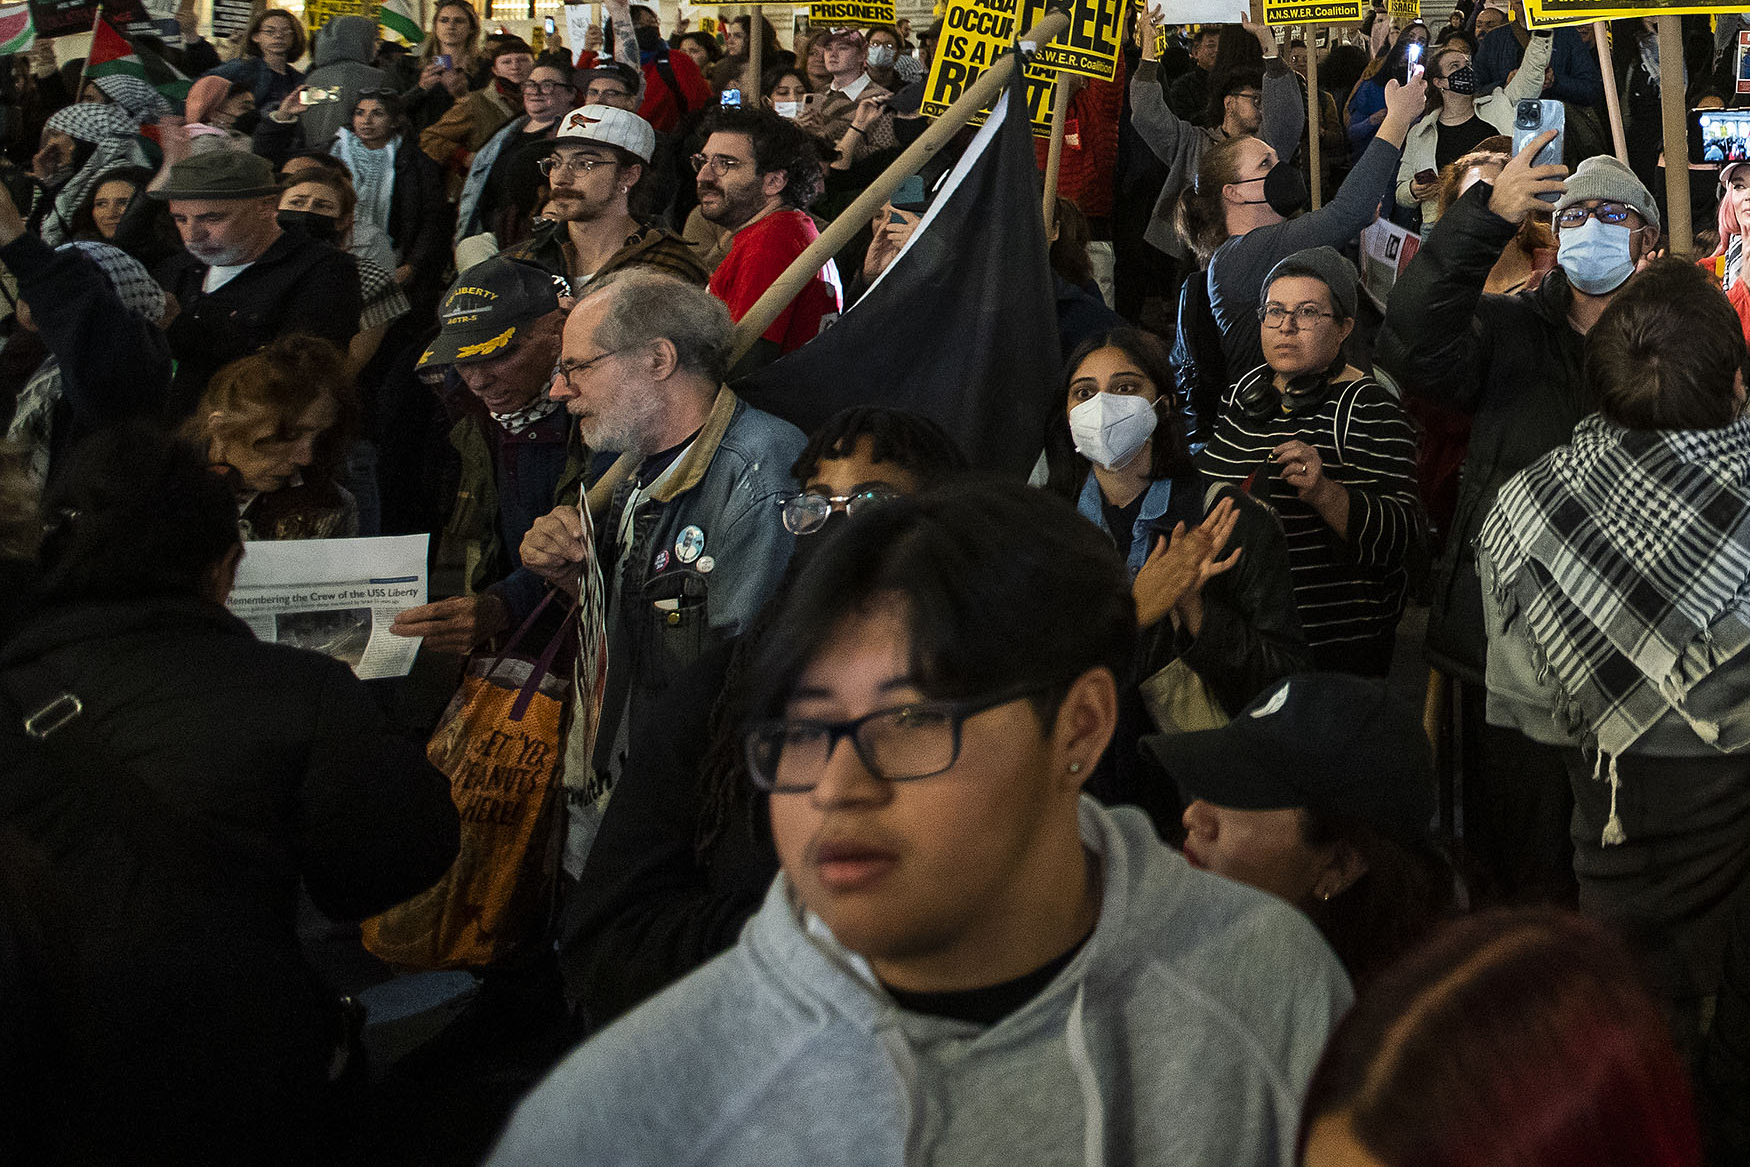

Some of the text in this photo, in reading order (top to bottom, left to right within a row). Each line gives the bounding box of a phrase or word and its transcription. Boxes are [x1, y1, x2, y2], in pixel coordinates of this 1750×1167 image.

[811, 5, 895, 21] PRISONERS
[1269, 6, 1356, 21] A.N.S.W.E.R. Coalition
[1392, 2, 1417, 12] ISRAEL!
[944, 34, 990, 65] IS A
[1080, 57, 1114, 75] Coalition
[454, 286, 499, 301] LIBERTY
[447, 315, 478, 325] AGTR-5
[227, 595, 291, 607] Remembering
[292, 593, 308, 603] the
[310, 591, 336, 603] Crew
[338, 590, 349, 600] of
[350, 590, 365, 599] the
[367, 588, 386, 598] USS
[388, 587, 419, 598] Liberty
[457, 761, 543, 794] PEANUTS
